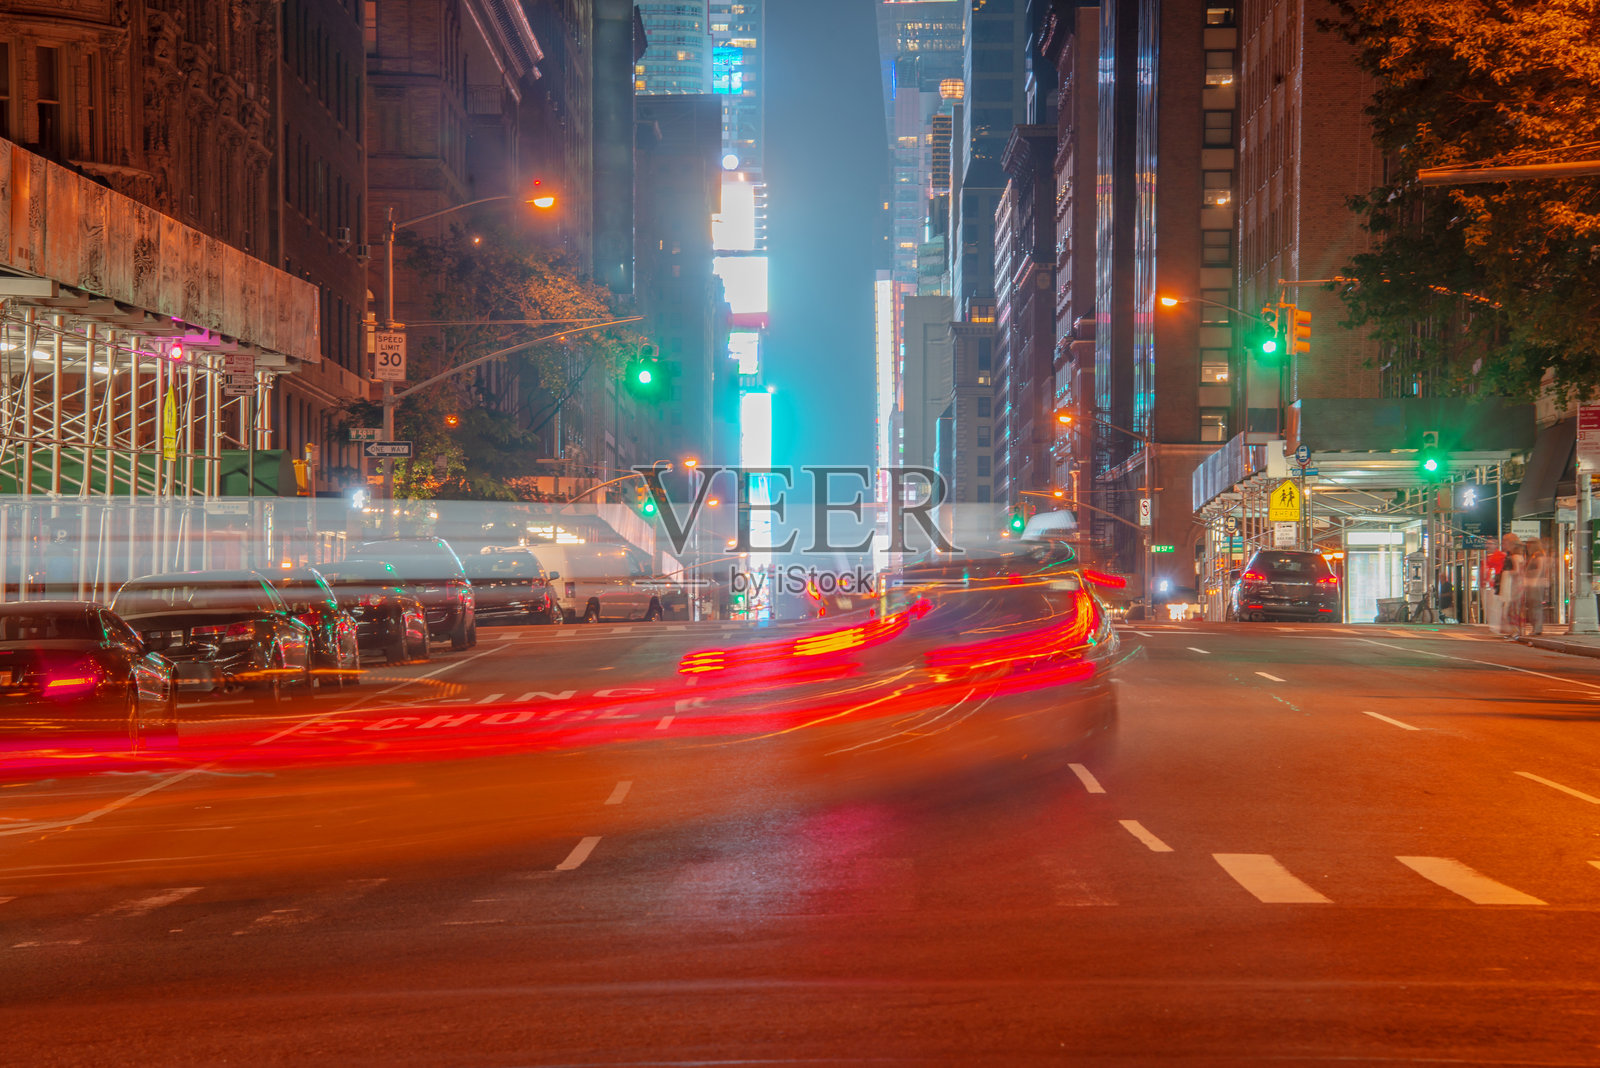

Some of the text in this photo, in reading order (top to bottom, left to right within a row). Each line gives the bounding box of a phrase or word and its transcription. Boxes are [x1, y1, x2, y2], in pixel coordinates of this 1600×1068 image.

[378, 335, 404, 344] SPEED
[379, 352, 402, 367] 30
[350, 430, 357, 439] W
[358, 430, 367, 439] 58
